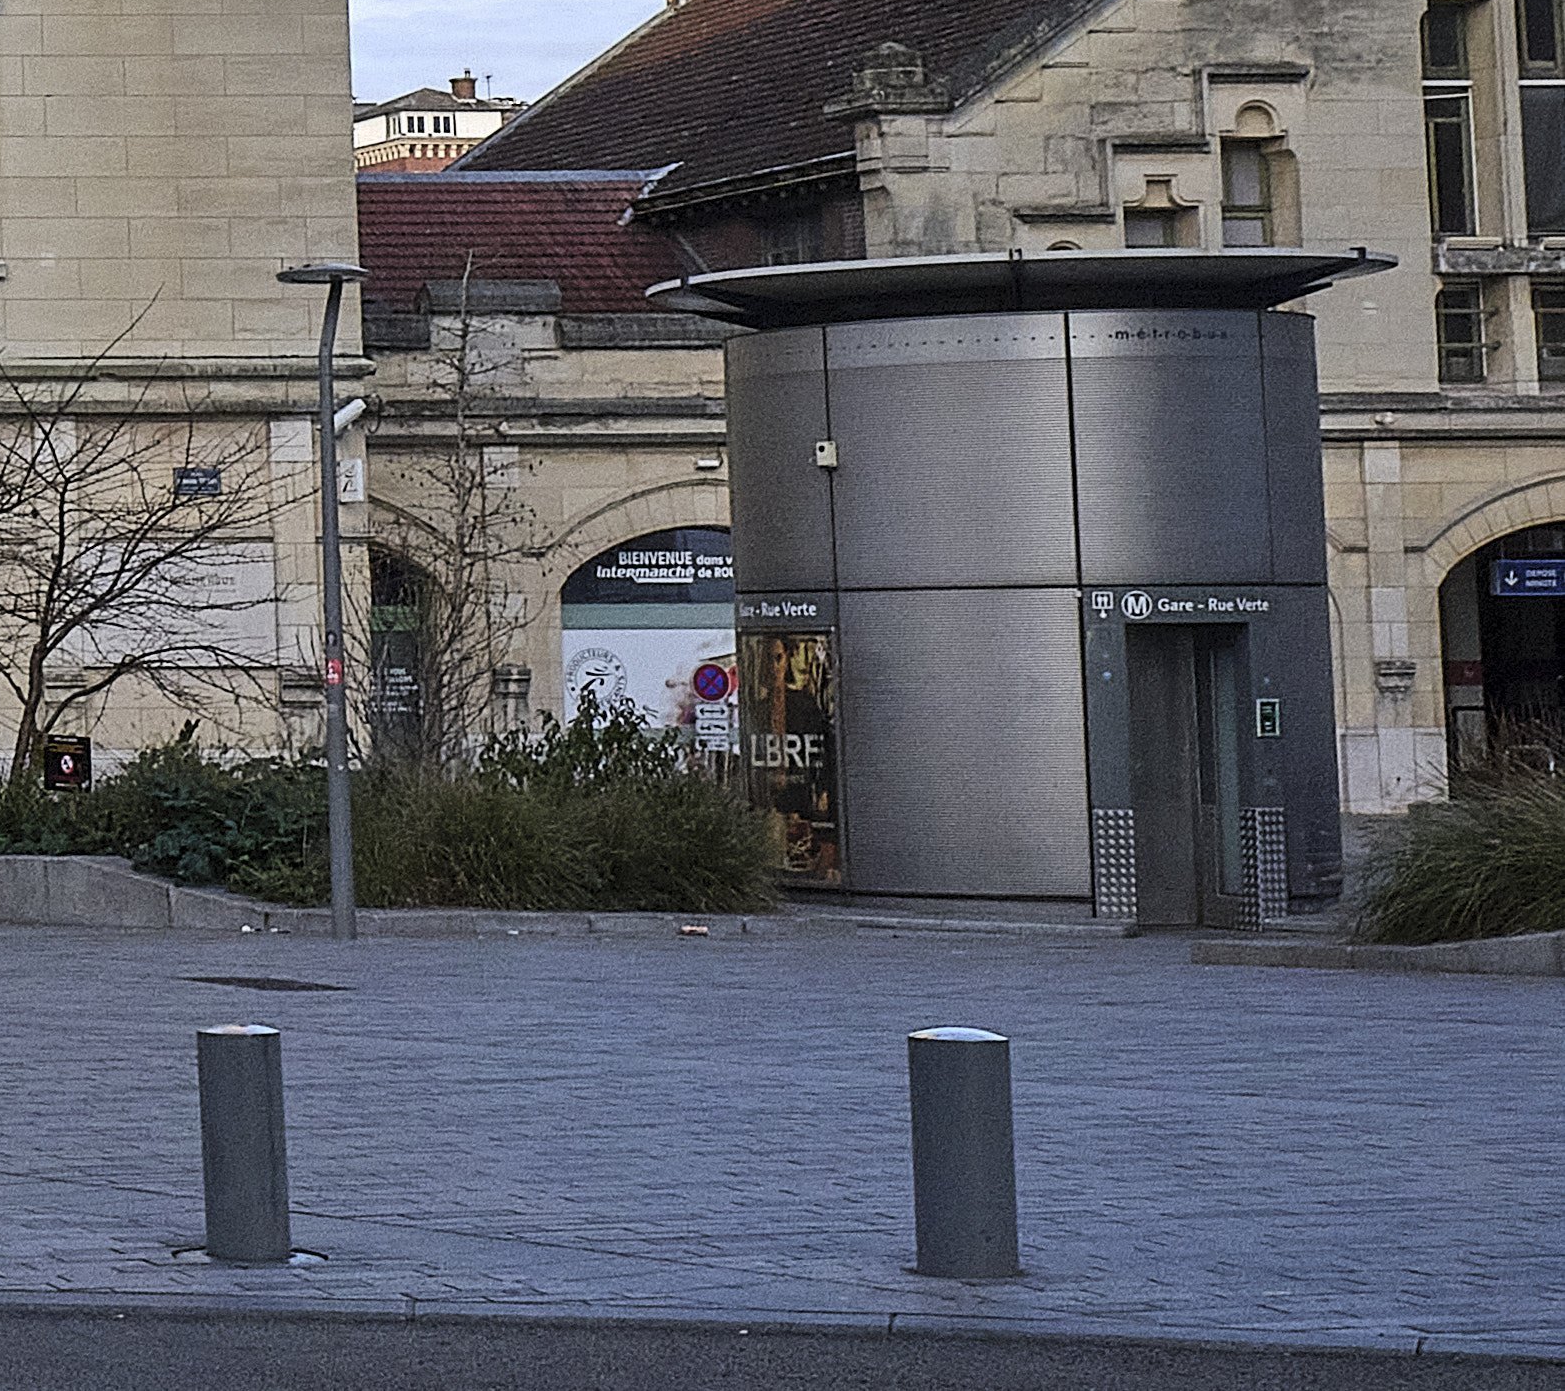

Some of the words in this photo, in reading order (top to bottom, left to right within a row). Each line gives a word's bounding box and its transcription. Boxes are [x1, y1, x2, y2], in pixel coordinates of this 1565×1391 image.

[618, 551, 692, 565] BIENVENUE
[696, 555, 723, 565] dans
[596, 565, 695, 580] Intermarché
[698, 568, 712, 578] de
[761, 601, 781, 617] Rue
[782, 601, 817, 617] Verte
[1157, 598, 1194, 612] Gare
[1207, 597, 1234, 612] Rue
[1236, 597, 1269, 612] Verte
